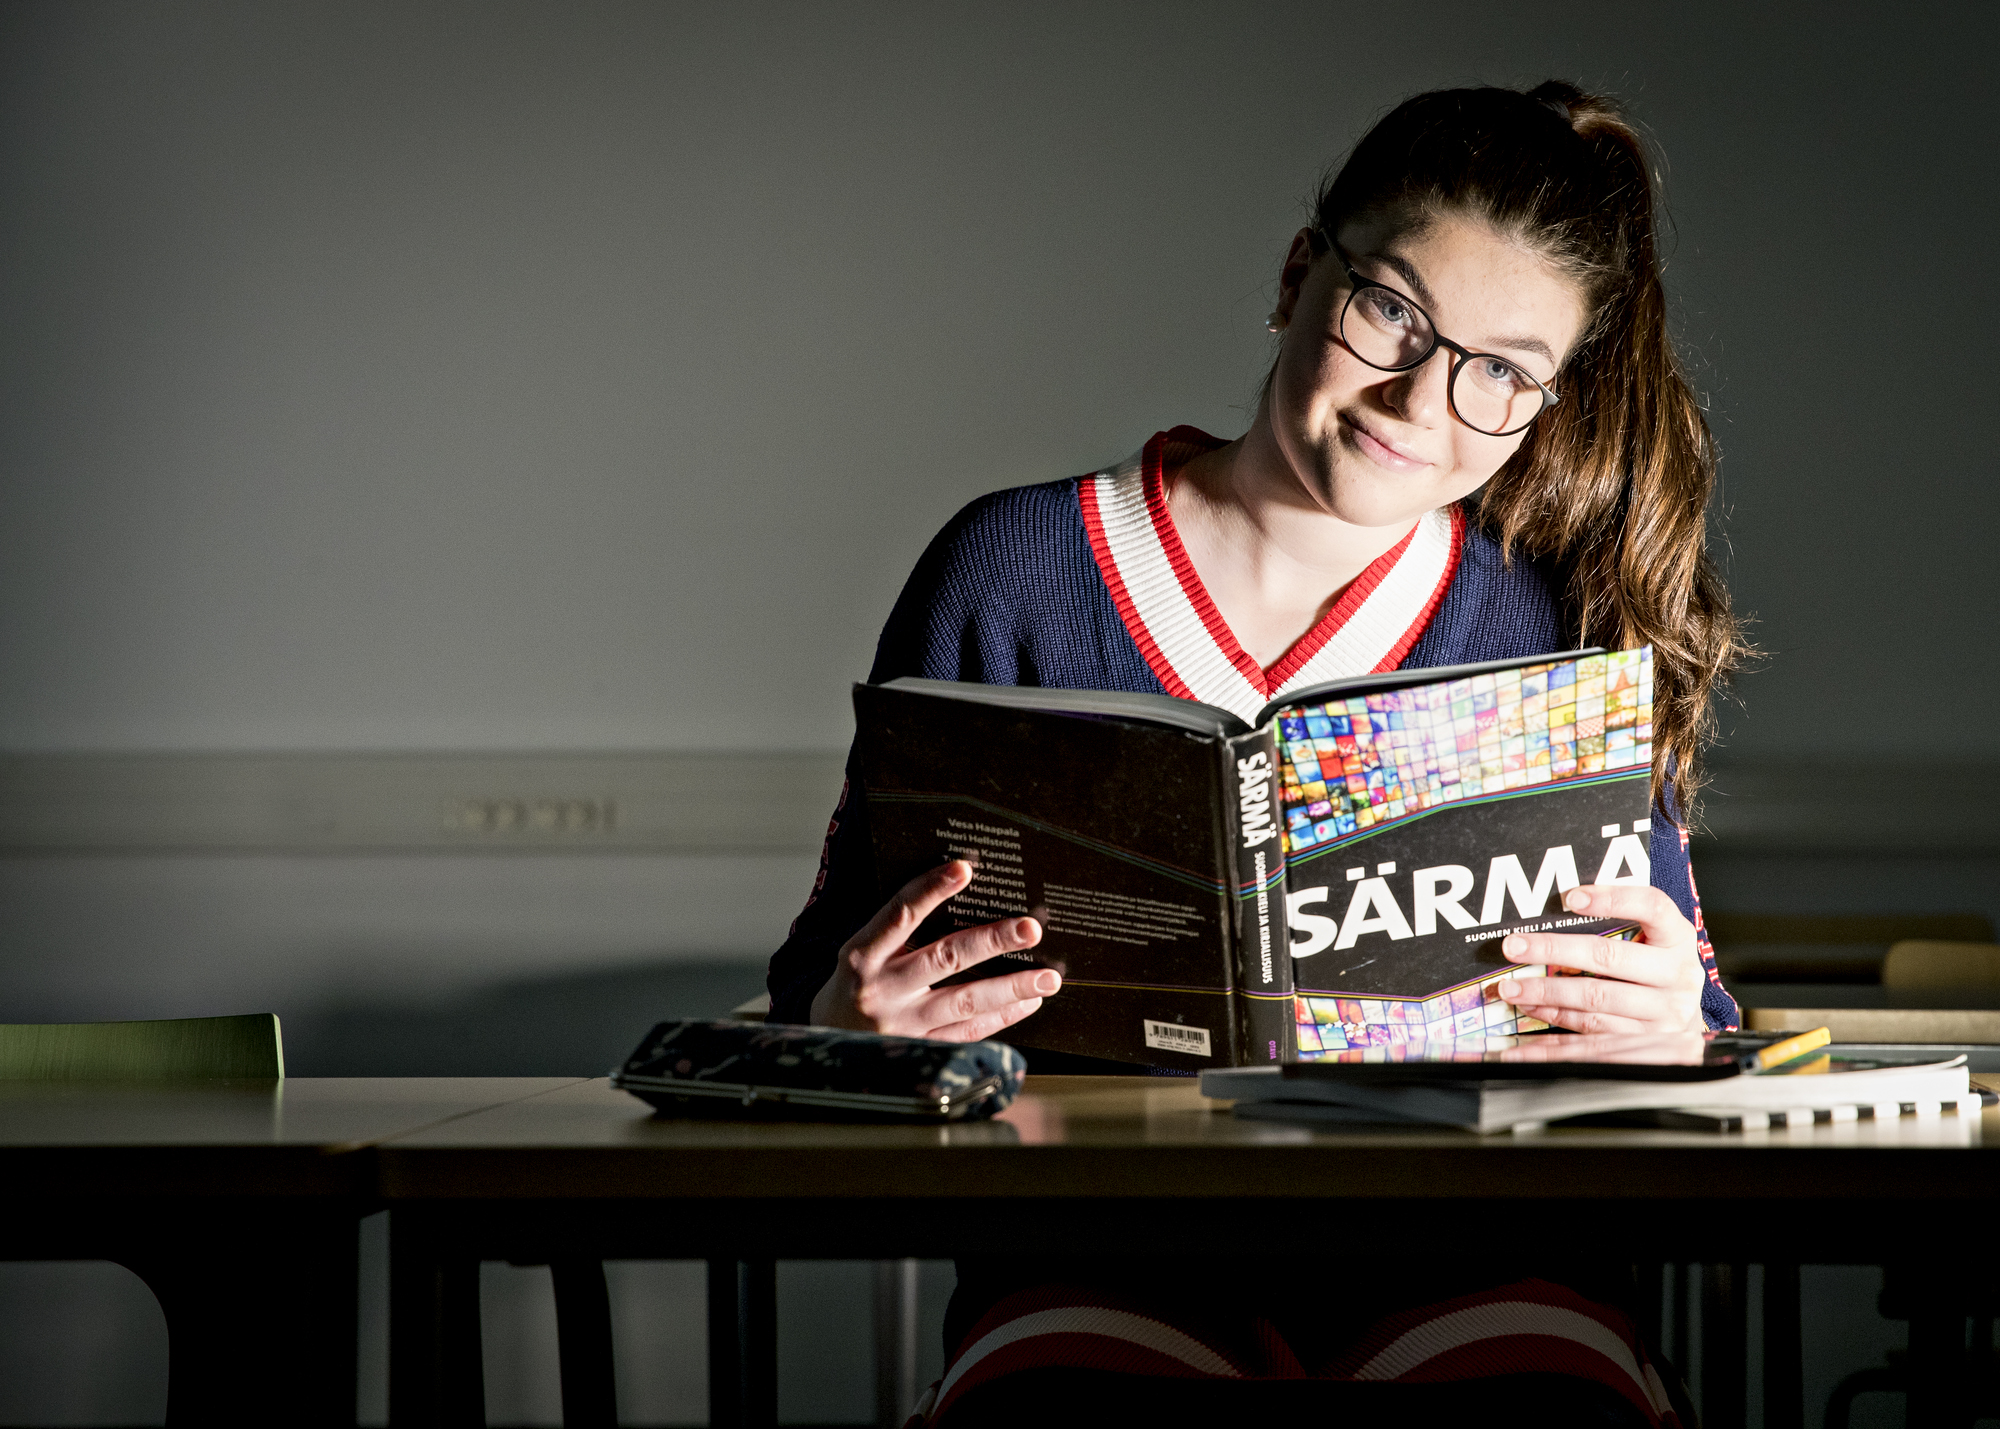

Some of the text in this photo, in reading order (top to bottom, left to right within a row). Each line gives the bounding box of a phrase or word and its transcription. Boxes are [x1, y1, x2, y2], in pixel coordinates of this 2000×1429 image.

[1237, 751, 1277, 848] SÄRMÄ
[947, 818, 1020, 837] Vesa Haapala
[936, 829, 1021, 850] Inkeri Hellström
[948, 843, 1023, 863] Janna Kantola
[986, 862, 1024, 876] Kaseva
[972, 872, 1026, 888] Korhonen
[1286, 818, 1651, 959] SÄRMÄ
[969, 884, 1027, 901] Heidi Kärki
[948, 905, 974, 917] Harri
[954, 894, 988, 907] Minna
[989, 899, 1029, 914] Maijala
[1254, 851, 1273, 984] SUOMEN KIELI JA KIRJALLISUUS
[1464, 928, 1511, 943] SUOMEN
[1513, 923, 1539, 935] KIELI
[1540, 922, 1554, 931] JA
